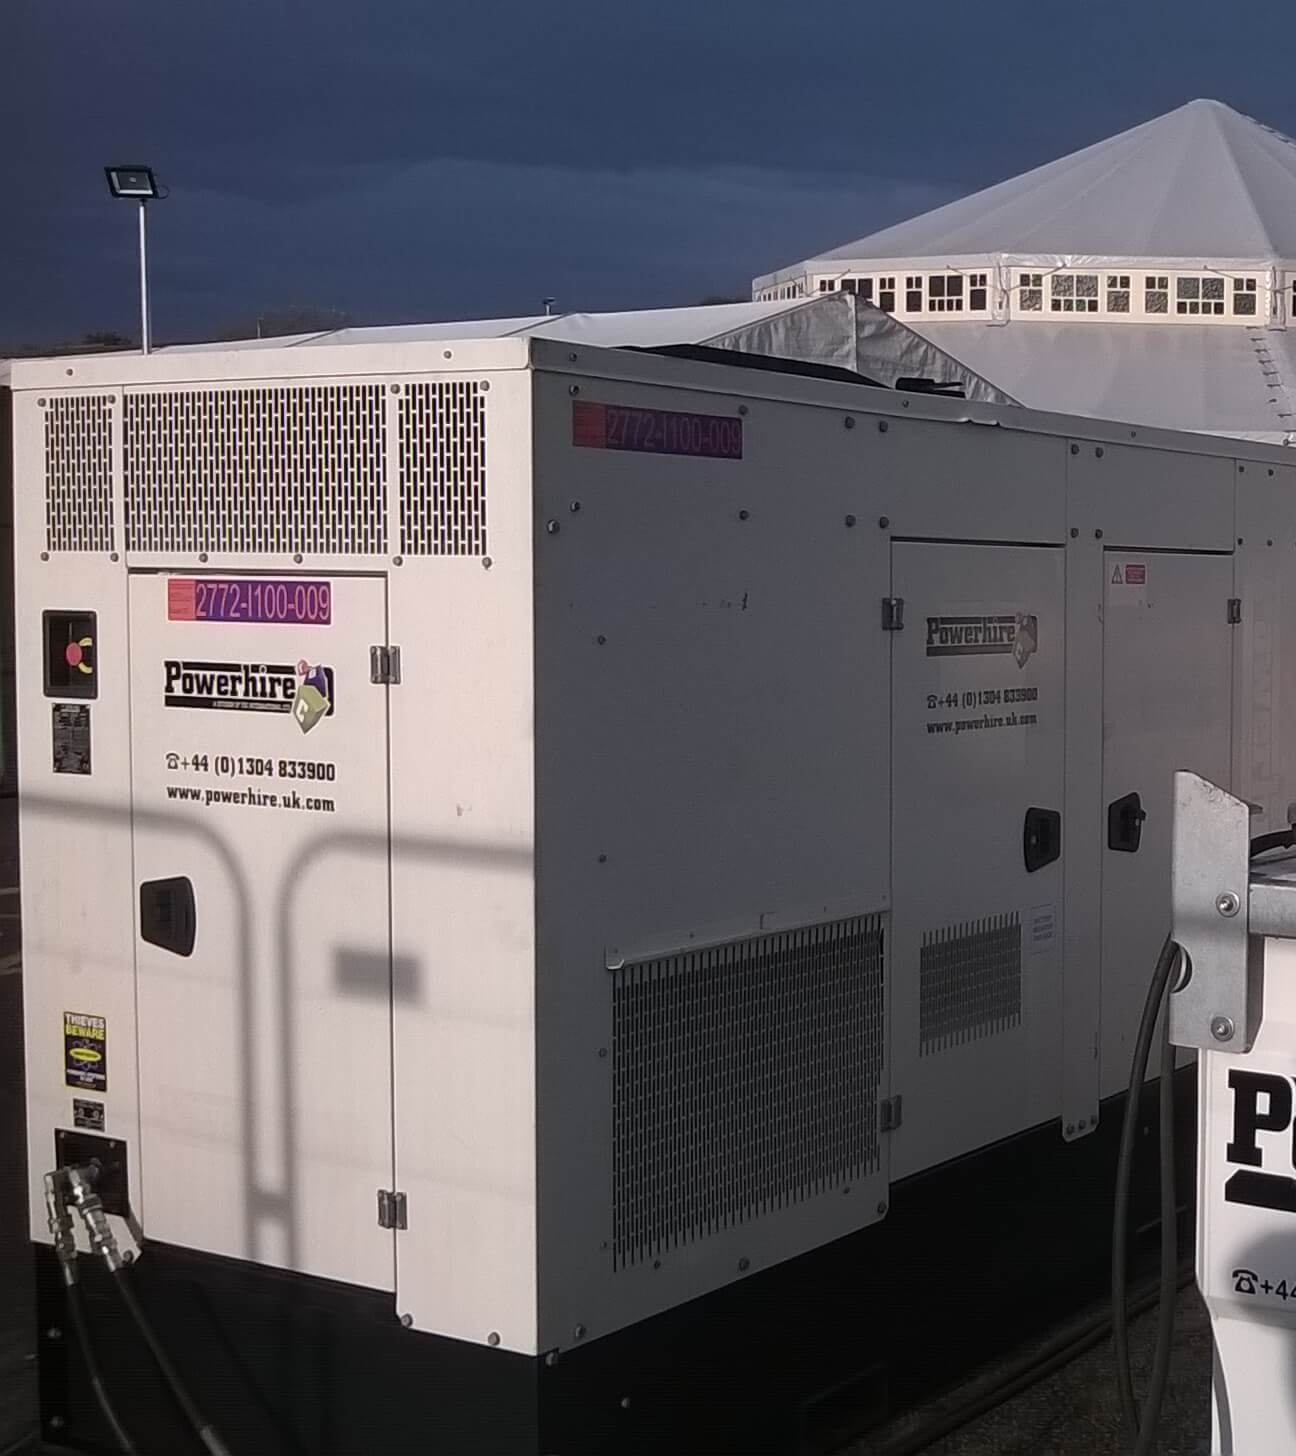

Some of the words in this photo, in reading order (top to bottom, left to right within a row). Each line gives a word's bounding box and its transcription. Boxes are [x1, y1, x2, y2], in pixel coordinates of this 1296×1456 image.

[927, 616, 1015, 645] Powerhire
[164, 661, 296, 699] Powerhire
[181, 754, 208, 772] +44
[215, 756, 274, 778] (0)1304
[278, 760, 335, 781] 833900
[167, 786, 335, 812] www.powerhire.uk.com
